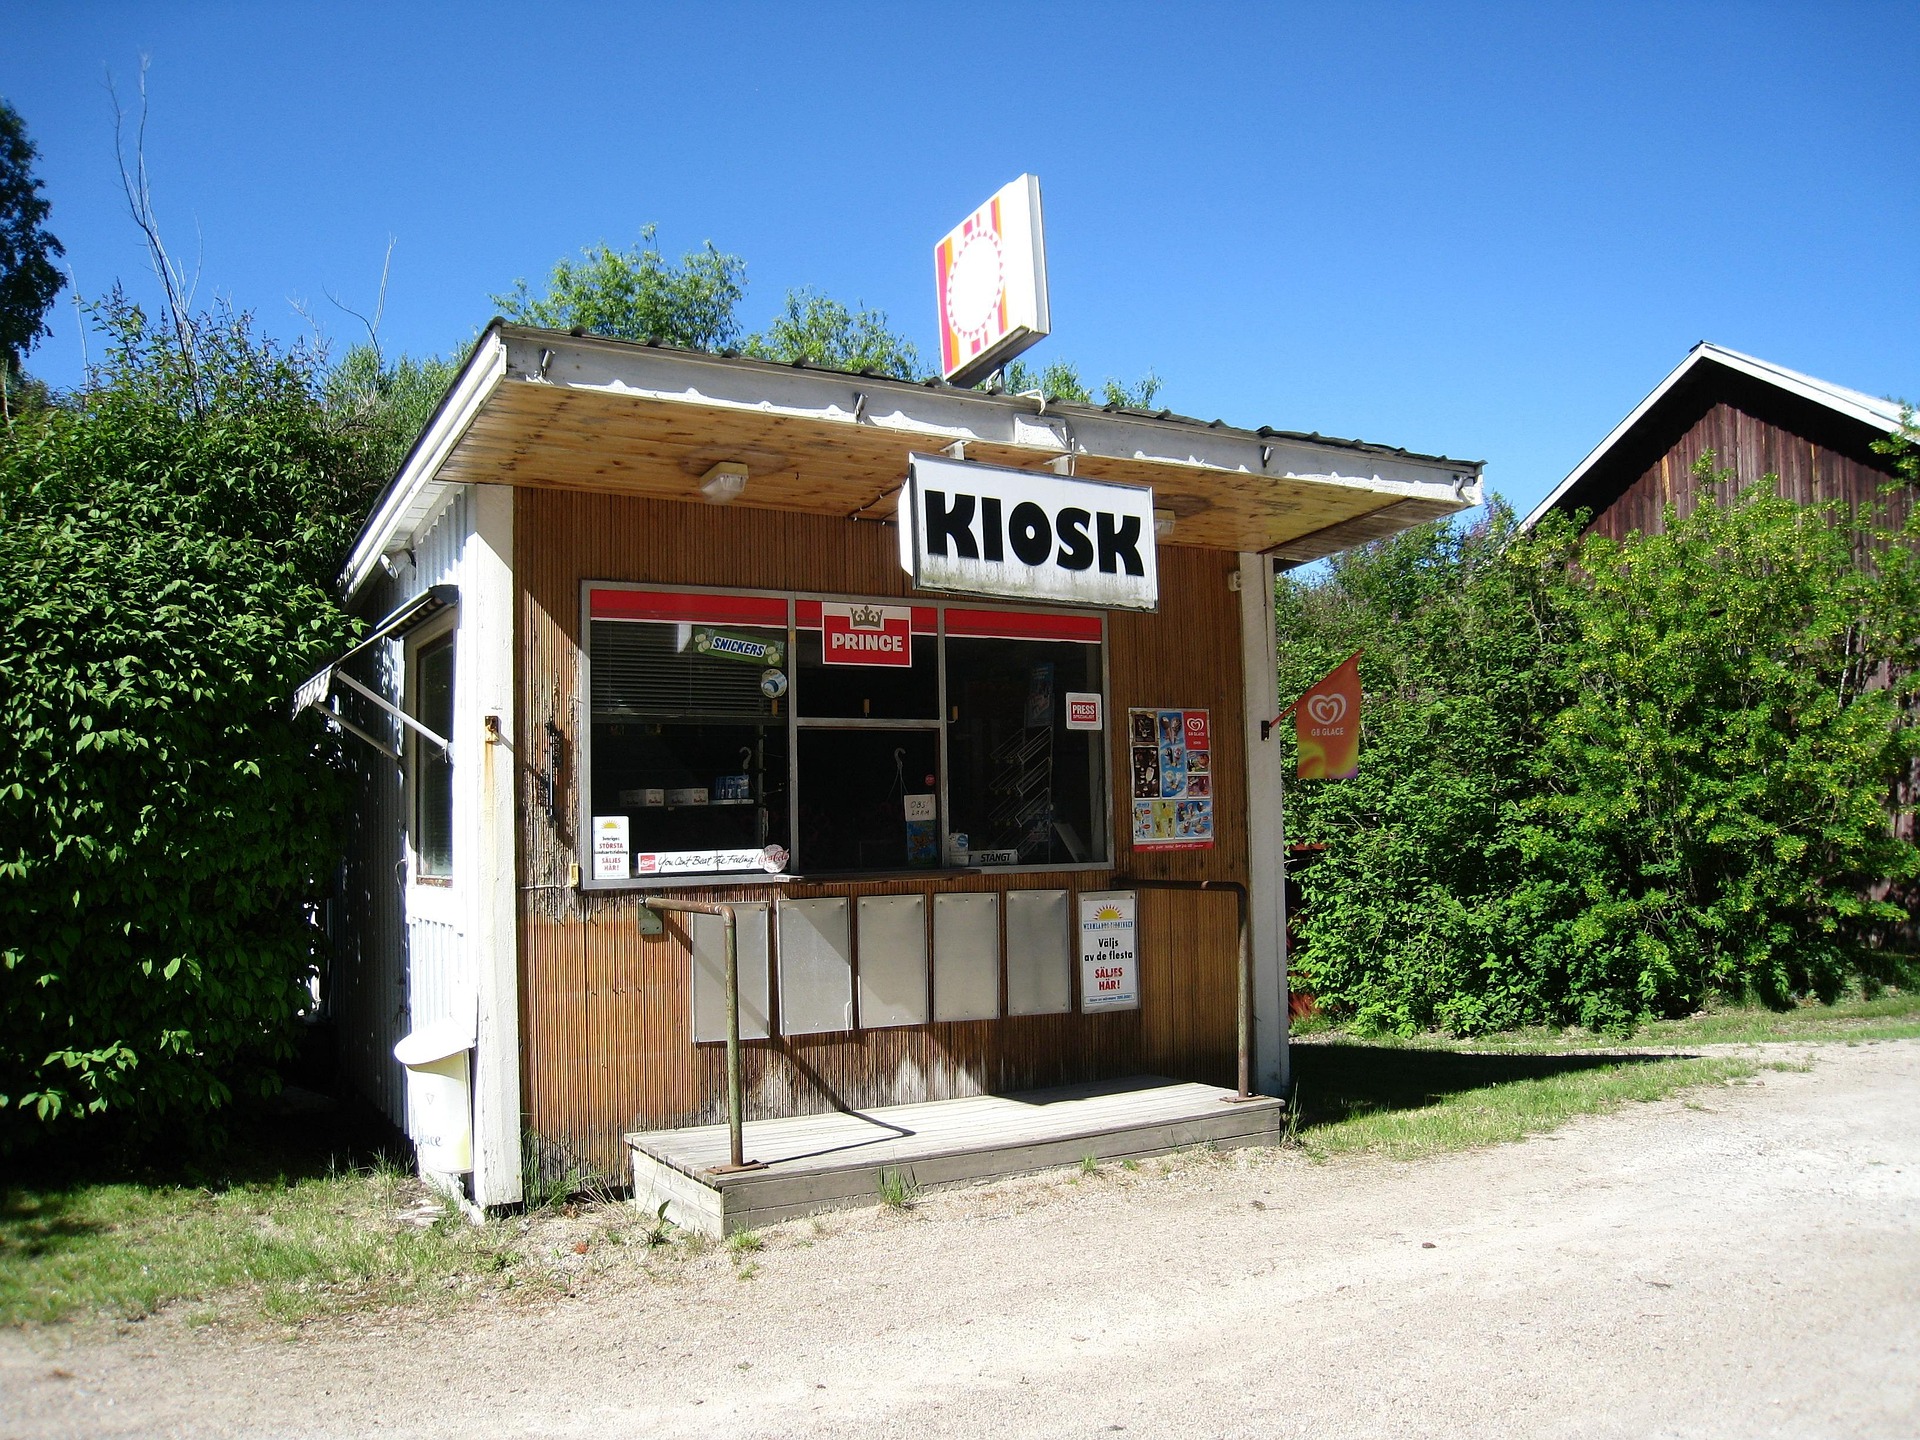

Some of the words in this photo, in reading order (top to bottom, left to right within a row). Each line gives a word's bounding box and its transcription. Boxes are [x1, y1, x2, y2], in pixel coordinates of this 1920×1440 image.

[924, 489, 1145, 577] KIOSK
[713, 637, 765, 657] SNICKERS
[831, 632, 904, 653] PRINCE
[1072, 704, 1095, 715] PRESS
[1311, 728, 1320, 736] GB
[1322, 727, 1344, 736] GLACE
[599, 841, 624, 849] STÖRSTA
[601, 856, 621, 864] SÄLJES
[657, 856, 674, 873] You
[692, 855, 712, 867] Beat
[713, 854, 727, 867] The
[604, 863, 620, 871] HÄR!
[1098, 937, 1119, 949] Väljs
[1084, 953, 1095, 962] av
[1096, 951, 1107, 960] de
[1109, 950, 1133, 960] flesta
[1095, 966, 1123, 979] SÄLJES
[1098, 978, 1121, 991] HÄR!
